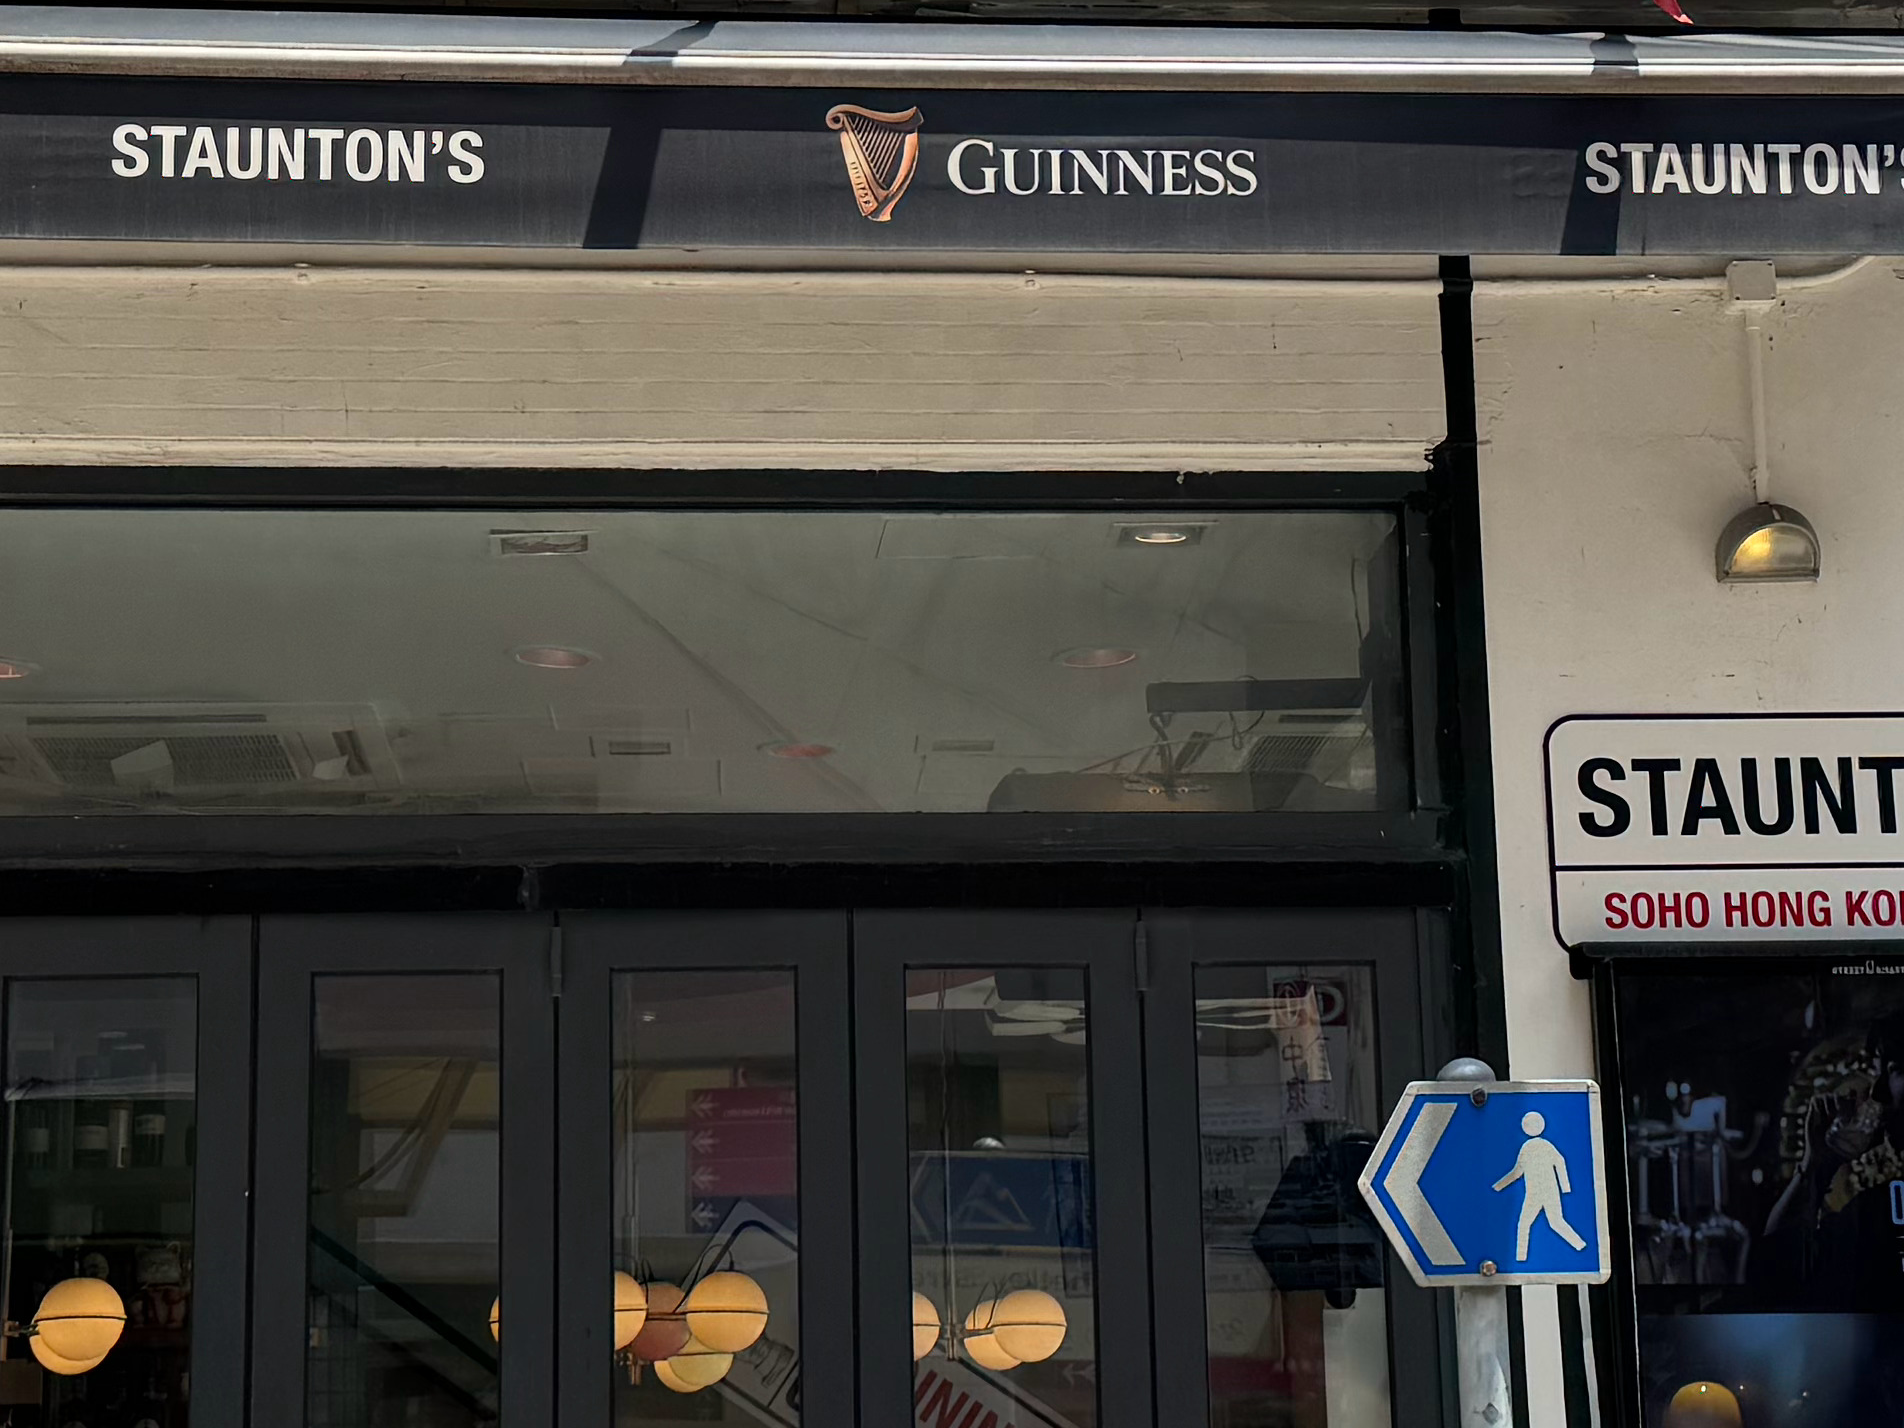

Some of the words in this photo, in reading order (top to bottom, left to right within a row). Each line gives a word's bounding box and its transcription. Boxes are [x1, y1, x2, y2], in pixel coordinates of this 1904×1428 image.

[112, 124, 485, 184] STAUNTON'S
[948, 139, 1257, 196] GUINNESS
[1604, 890, 1709, 931] SOHO
[1723, 889, 1834, 929] HONG
